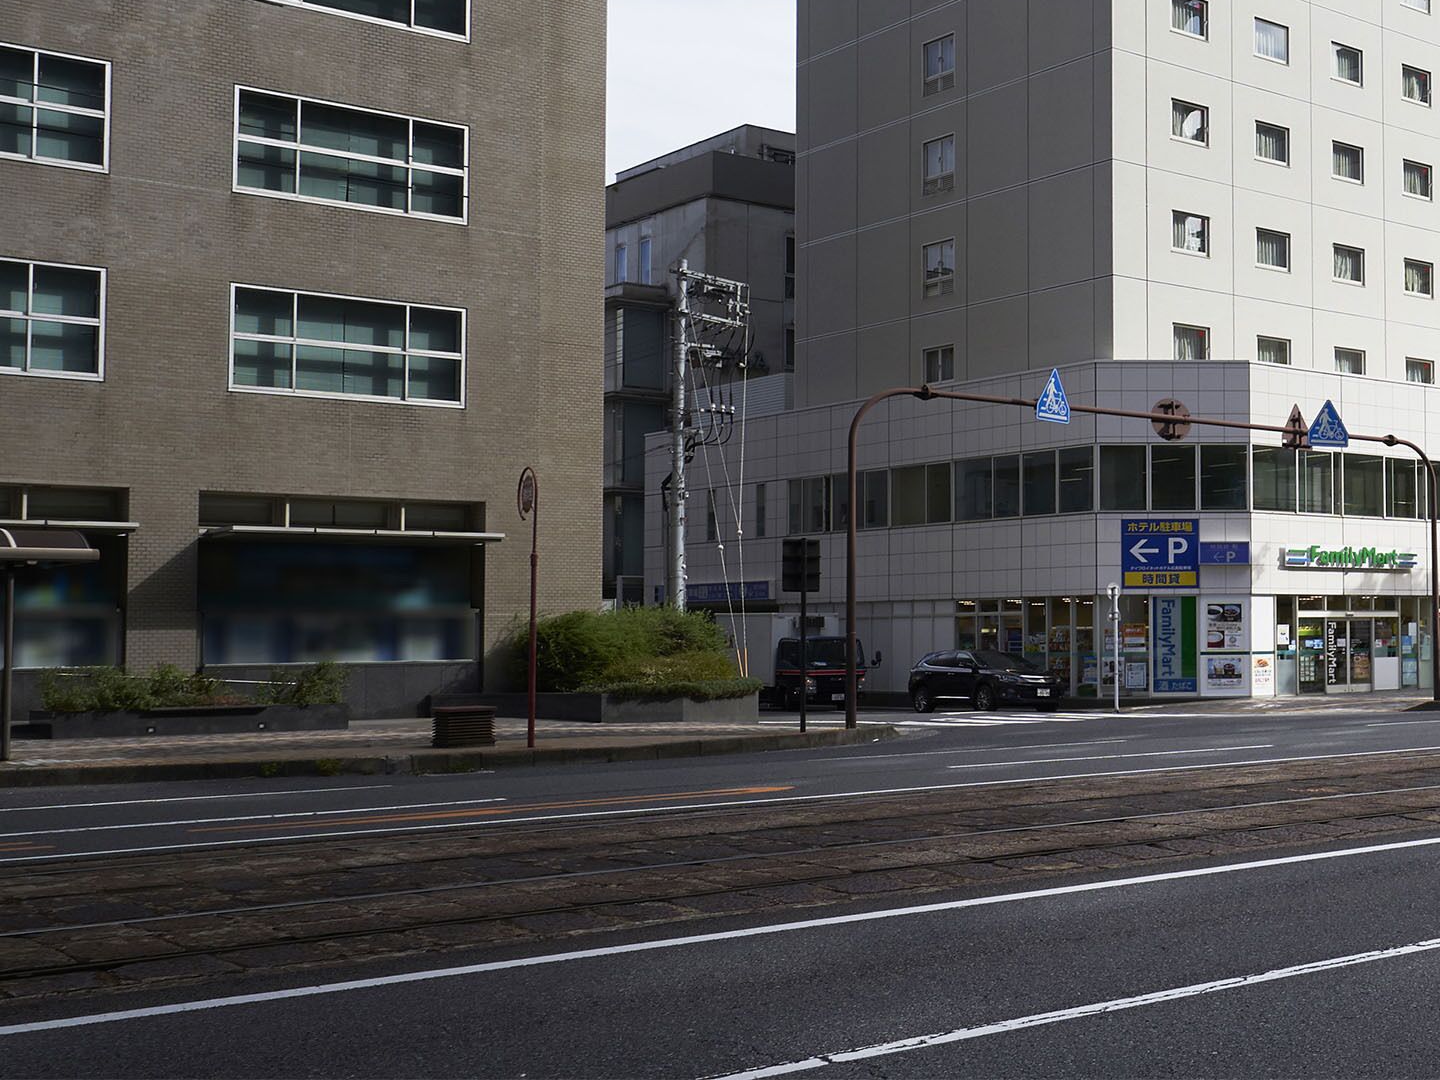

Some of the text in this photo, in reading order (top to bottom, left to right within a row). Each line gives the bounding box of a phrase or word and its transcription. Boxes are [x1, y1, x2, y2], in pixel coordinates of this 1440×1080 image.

[1127, 521, 1193, 532] ホテル駐車場
[1168, 537, 1189, 564] P
[1310, 545, 1398, 568] FamilyMart
[1142, 573, 1181, 585] 時間貸
[1158, 599, 1175, 677] FamilyMart
[1328, 621, 1337, 684] FamilyMart
